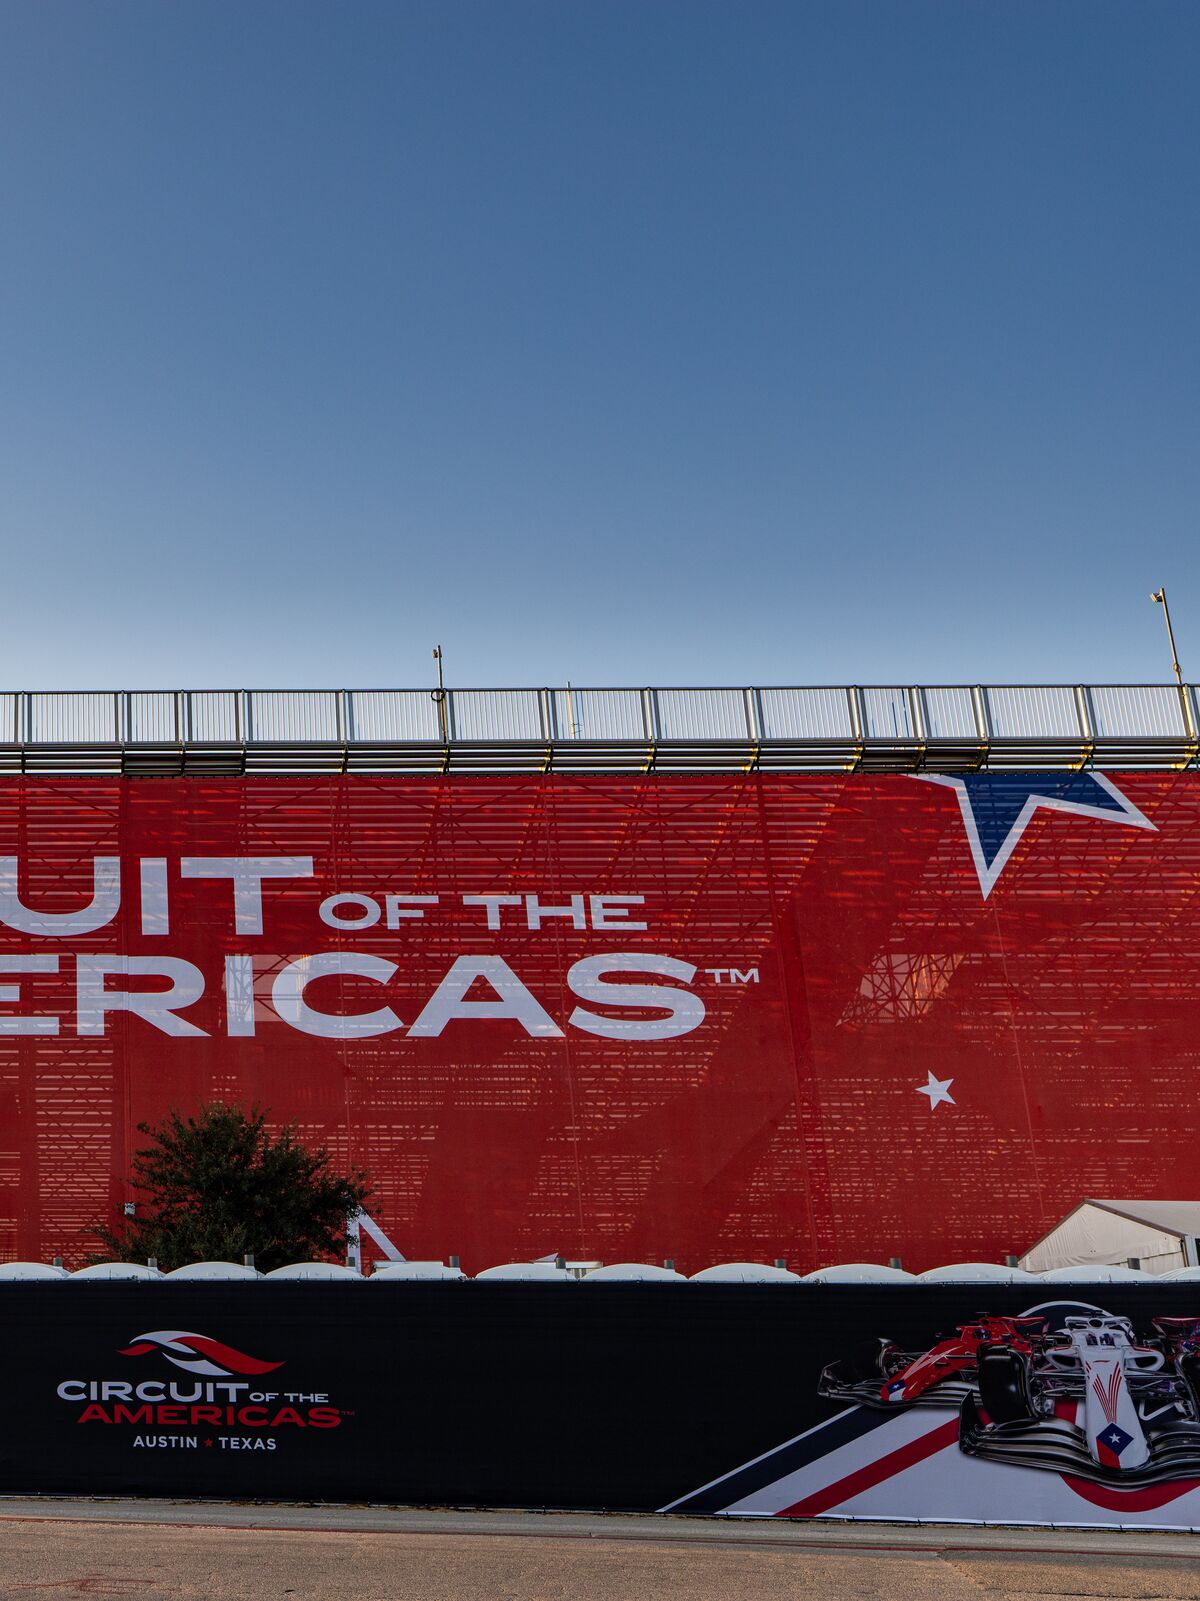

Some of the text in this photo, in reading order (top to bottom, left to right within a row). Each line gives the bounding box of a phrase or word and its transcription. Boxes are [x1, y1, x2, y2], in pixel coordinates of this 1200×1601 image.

[319, 893, 440, 931] OF
[463, 894, 648, 931] THE
[56, 1380, 329, 1403] CIRCUIT OF THE
[77, 1404, 342, 1429] AMERICAS
[133, 1435, 277, 1450] AUSTIN TEXAS
